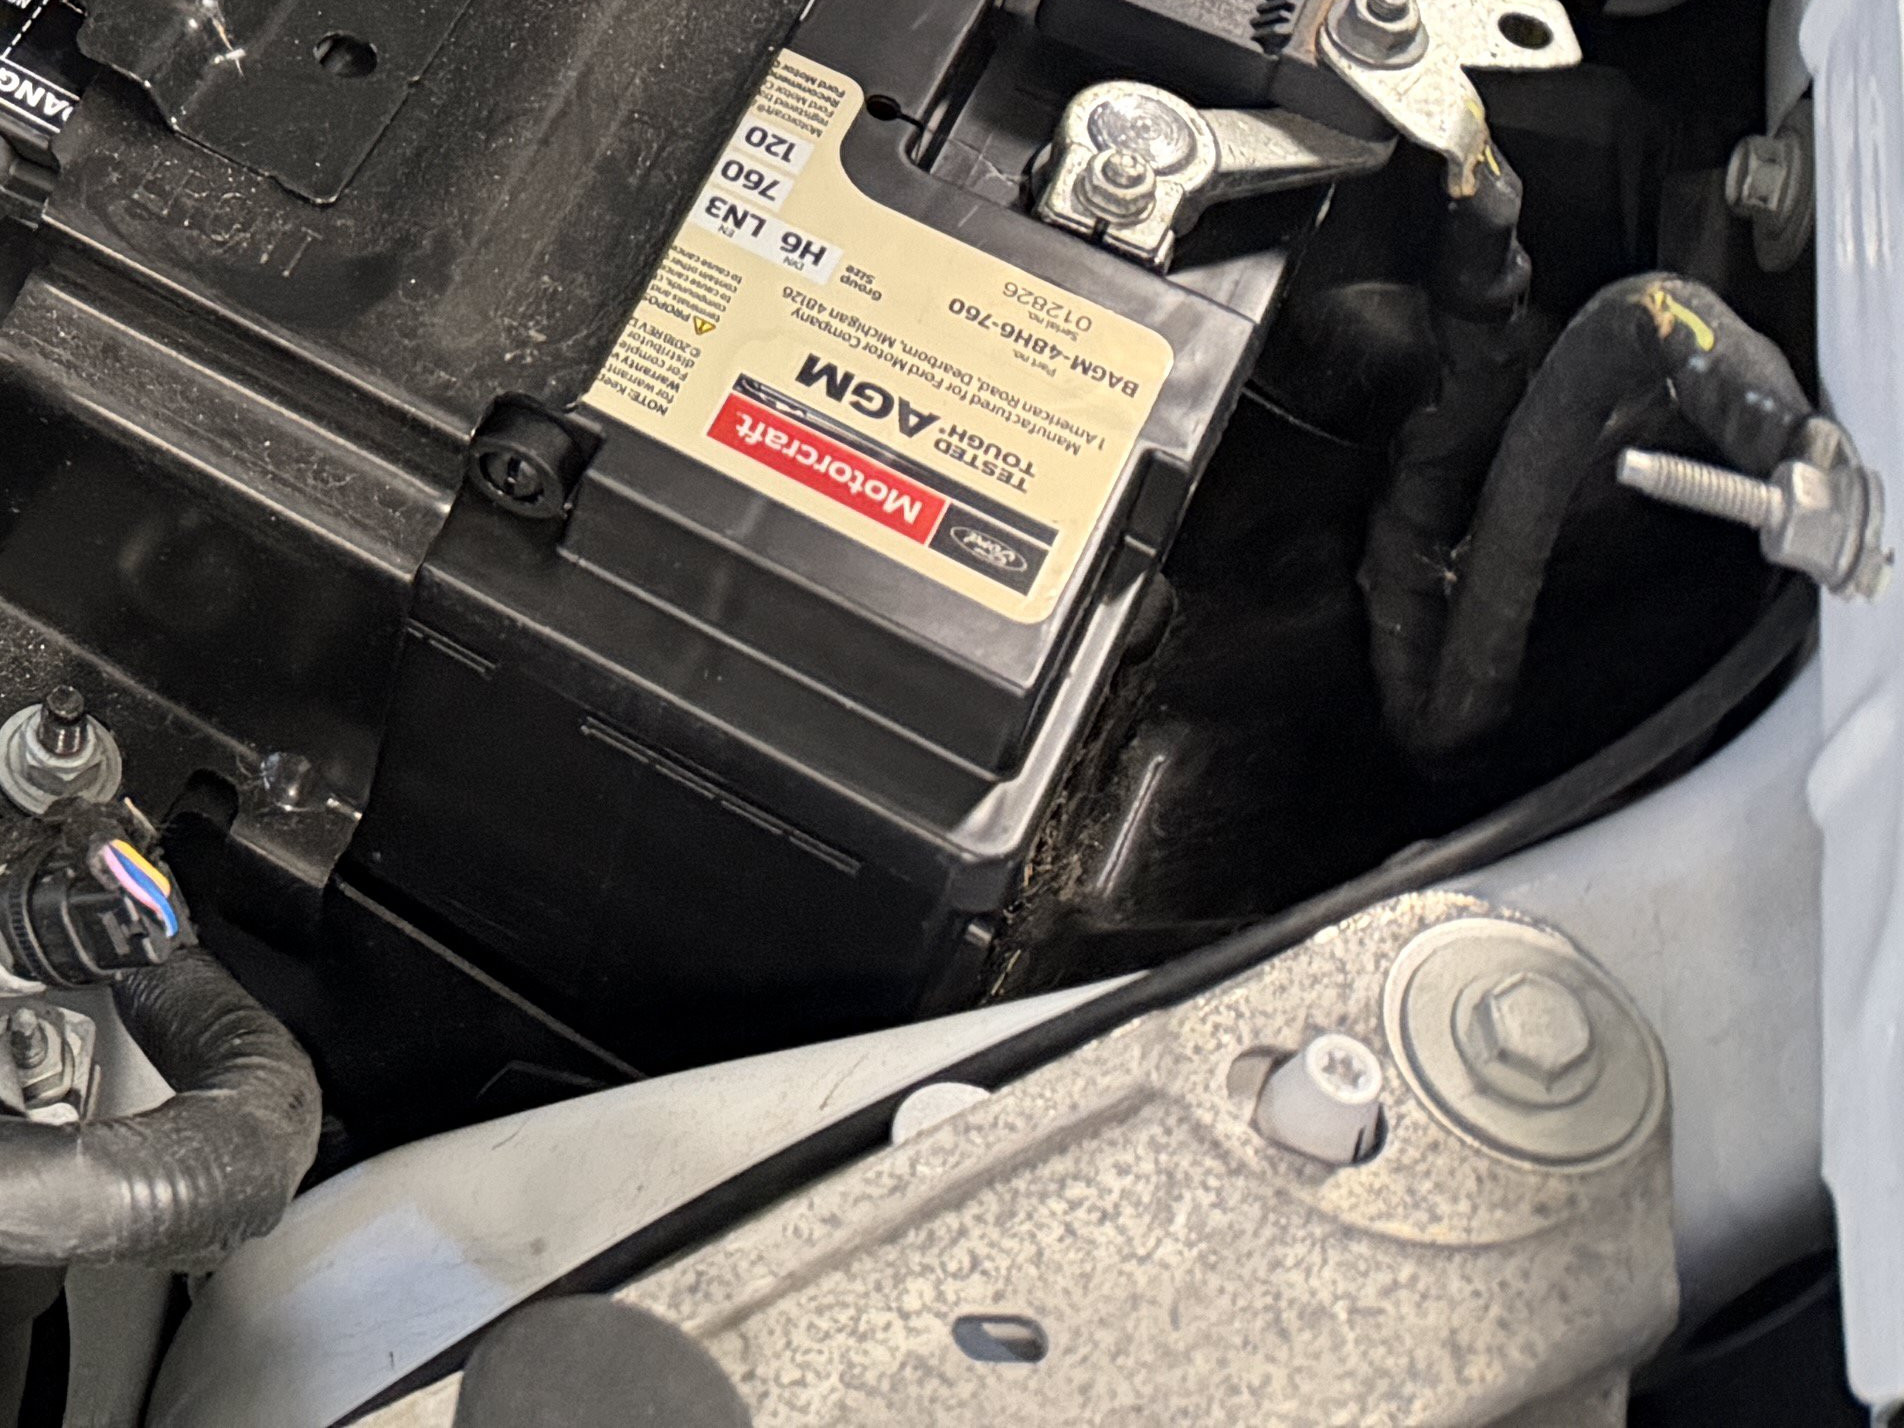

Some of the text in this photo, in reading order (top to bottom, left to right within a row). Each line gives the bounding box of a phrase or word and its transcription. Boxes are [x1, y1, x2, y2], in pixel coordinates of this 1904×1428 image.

[742, 122, 798, 163] 120
[718, 156, 783, 202] 760
[703, 193, 827, 267] H6 LN3
[717, 223, 735, 238] EN
[837, 272, 883, 302] Group
[843, 263, 875, 286] Size
[780, 284, 829, 316] 48126
[1000, 278, 1094, 333] 012826
[827, 305, 898, 349] Michigan
[946, 295, 1140, 398] BAGM-48H6-760
[1044, 319, 1079, 342] Serial
[626, 329, 695, 370] distributor
[1029, 357, 1057, 377] Part
[601, 361, 675, 405] for warrant
[619, 353, 681, 393] Warranty
[664, 362, 689, 381] For
[789, 304, 1082, 456] Manufactured for Ford Motor Company
[626, 387, 669, 416] NOTE:
[793, 351, 940, 444] AGM
[972, 376, 1021, 409] Road,
[1019, 400, 1097, 446] American
[730, 411, 924, 526] Motorcraft
[932, 434, 1031, 493] TESTED
